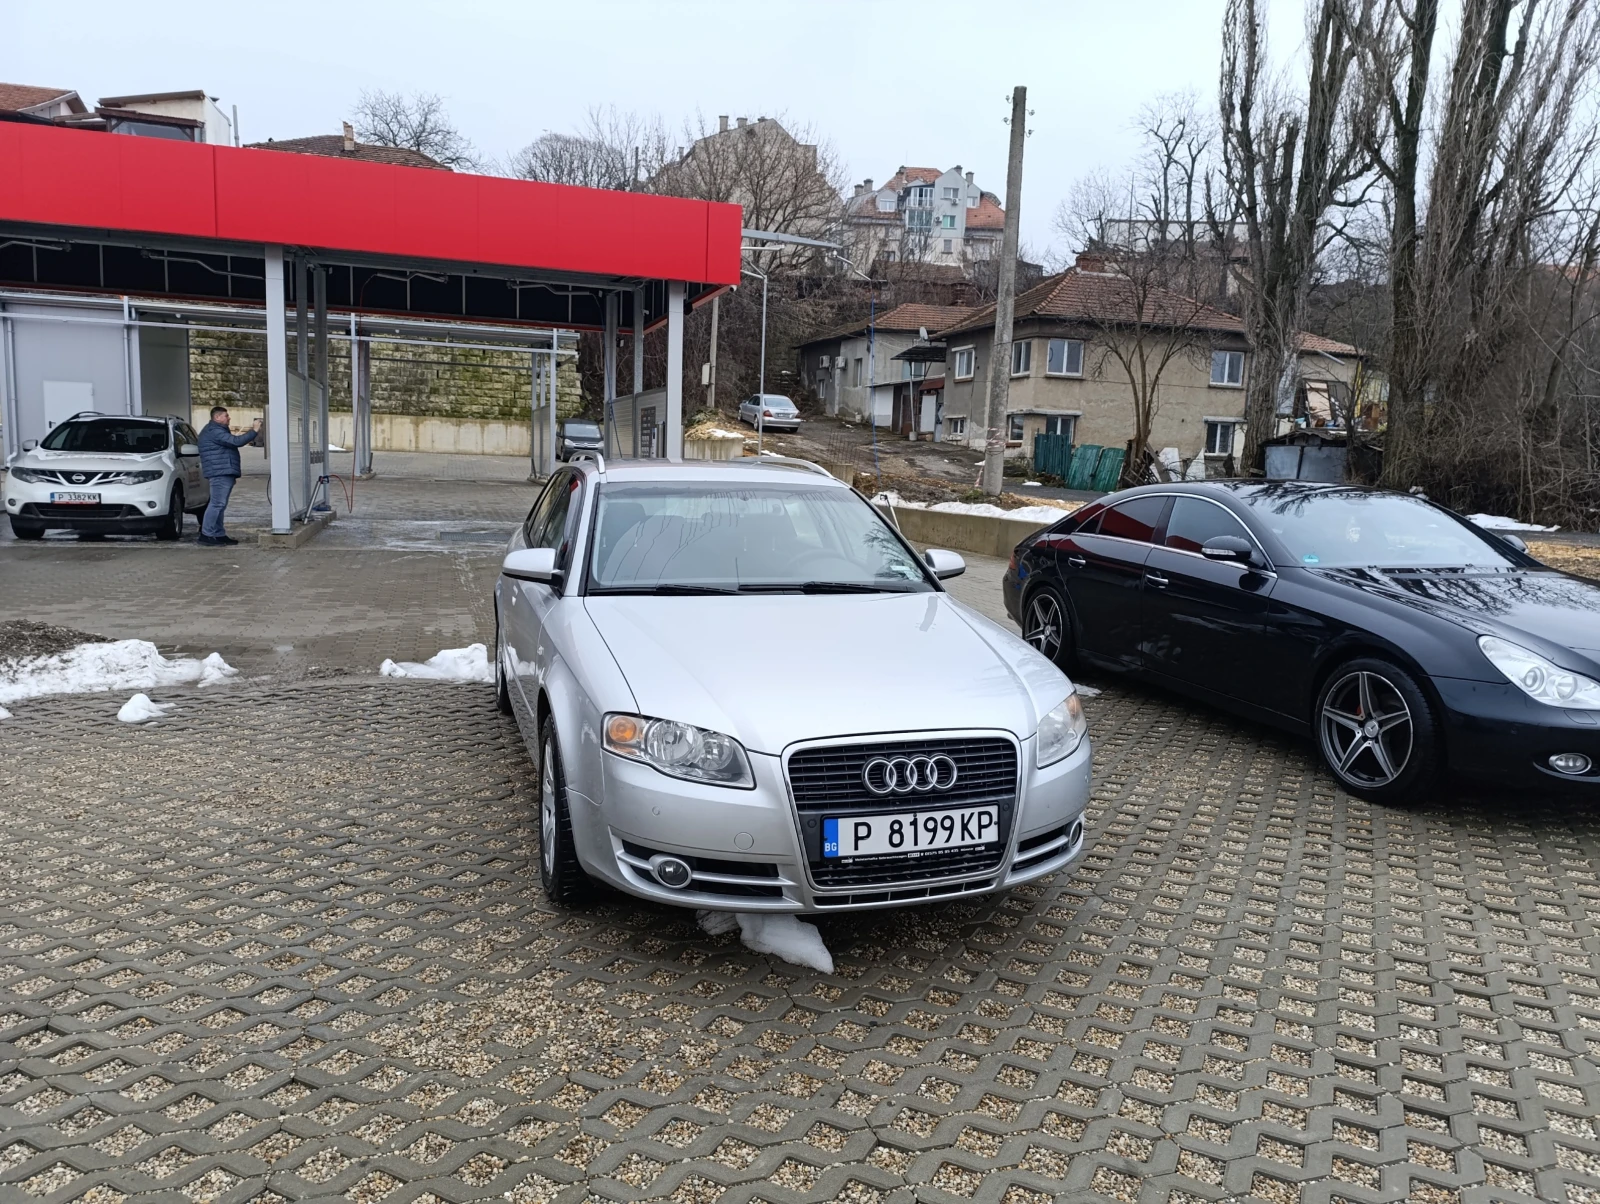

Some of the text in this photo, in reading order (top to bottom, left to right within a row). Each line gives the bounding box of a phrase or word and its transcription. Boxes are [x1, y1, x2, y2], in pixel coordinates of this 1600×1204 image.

[58, 493, 64, 501] P
[854, 821, 872, 851] P
[824, 842, 838, 852] BG
